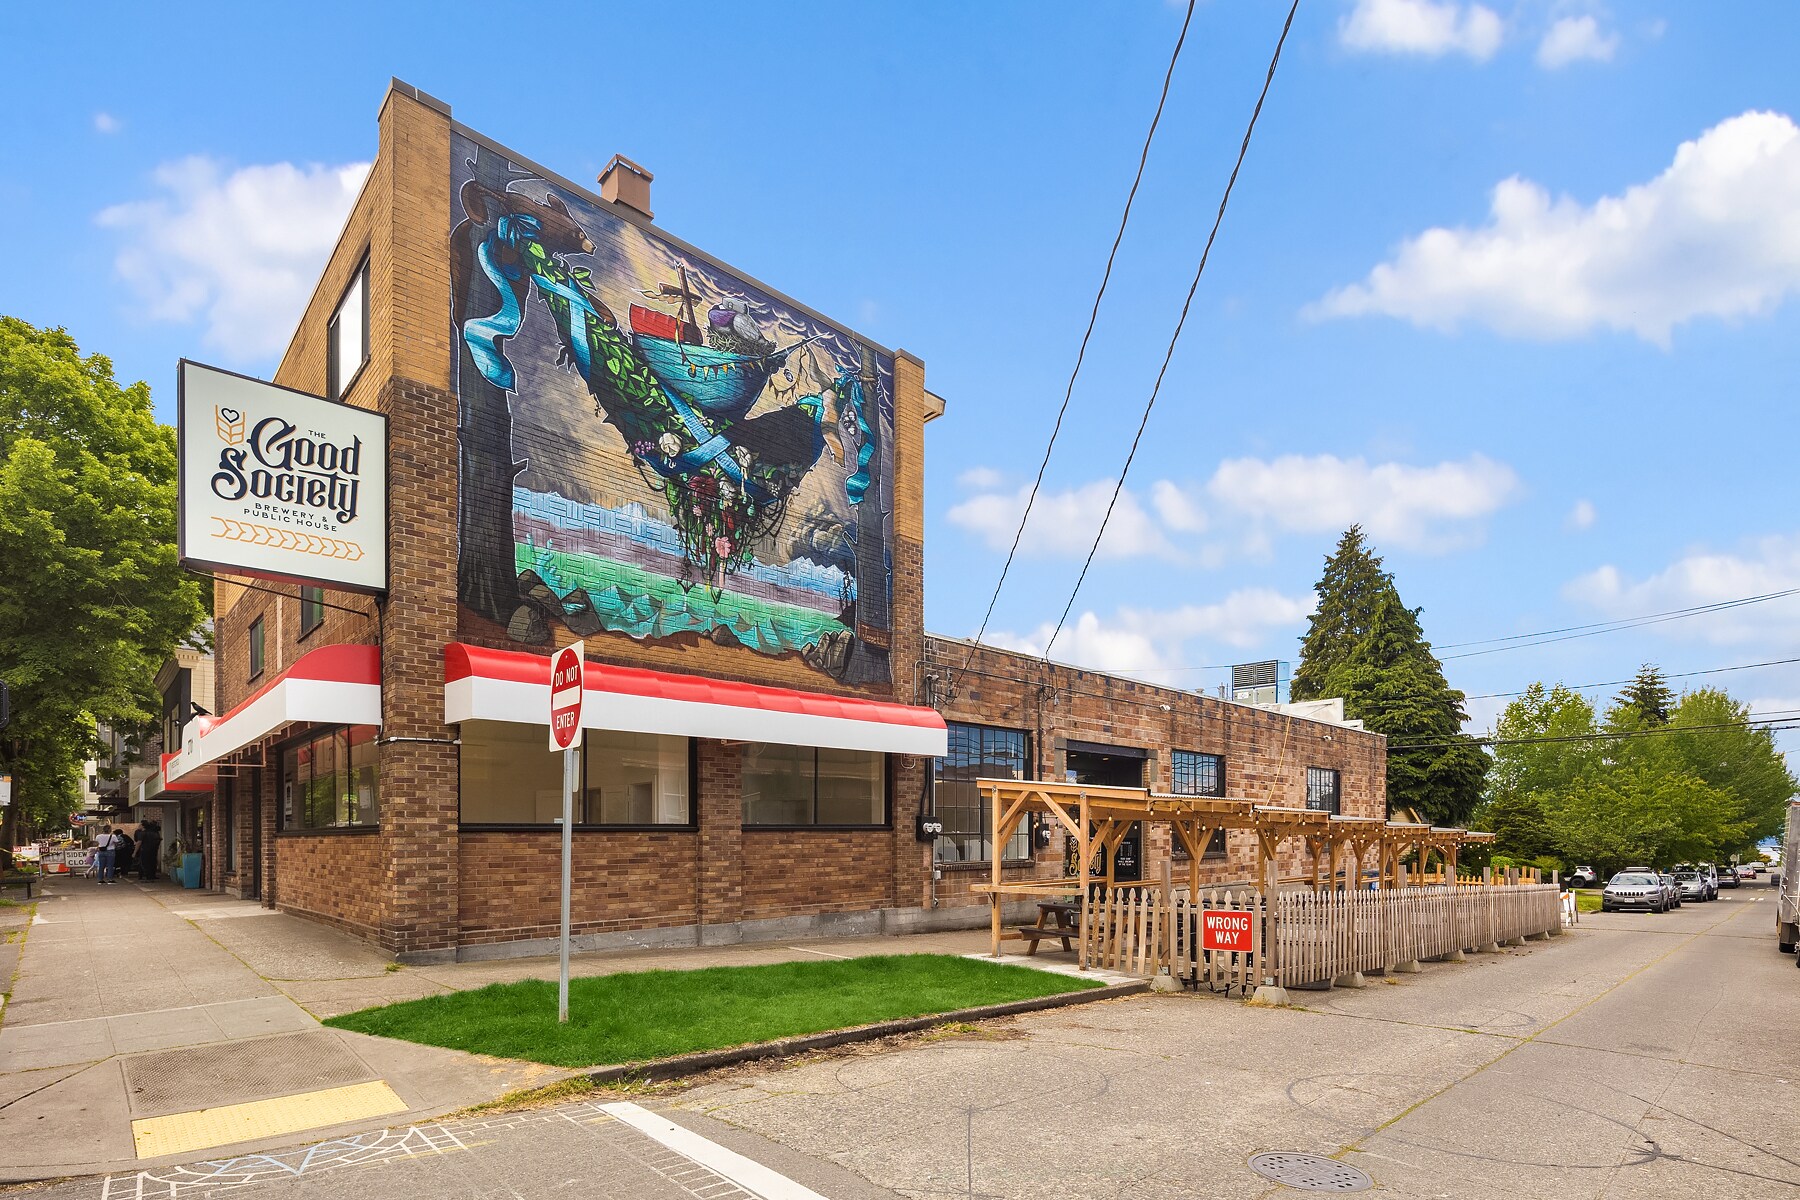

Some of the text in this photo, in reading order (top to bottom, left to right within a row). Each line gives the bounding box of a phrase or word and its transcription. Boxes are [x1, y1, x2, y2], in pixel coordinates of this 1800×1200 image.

[308, 430, 326, 439] THE
[246, 417, 362, 476] Good
[243, 508, 337, 532] PUBLIC HOUSE
[255, 502, 328, 523] BREWERY &
[556, 665, 578, 687] DO NOT
[556, 712, 575, 729] ENTER
[1206, 916, 1248, 931] WRONG
[1215, 931, 1239, 945] WAY
